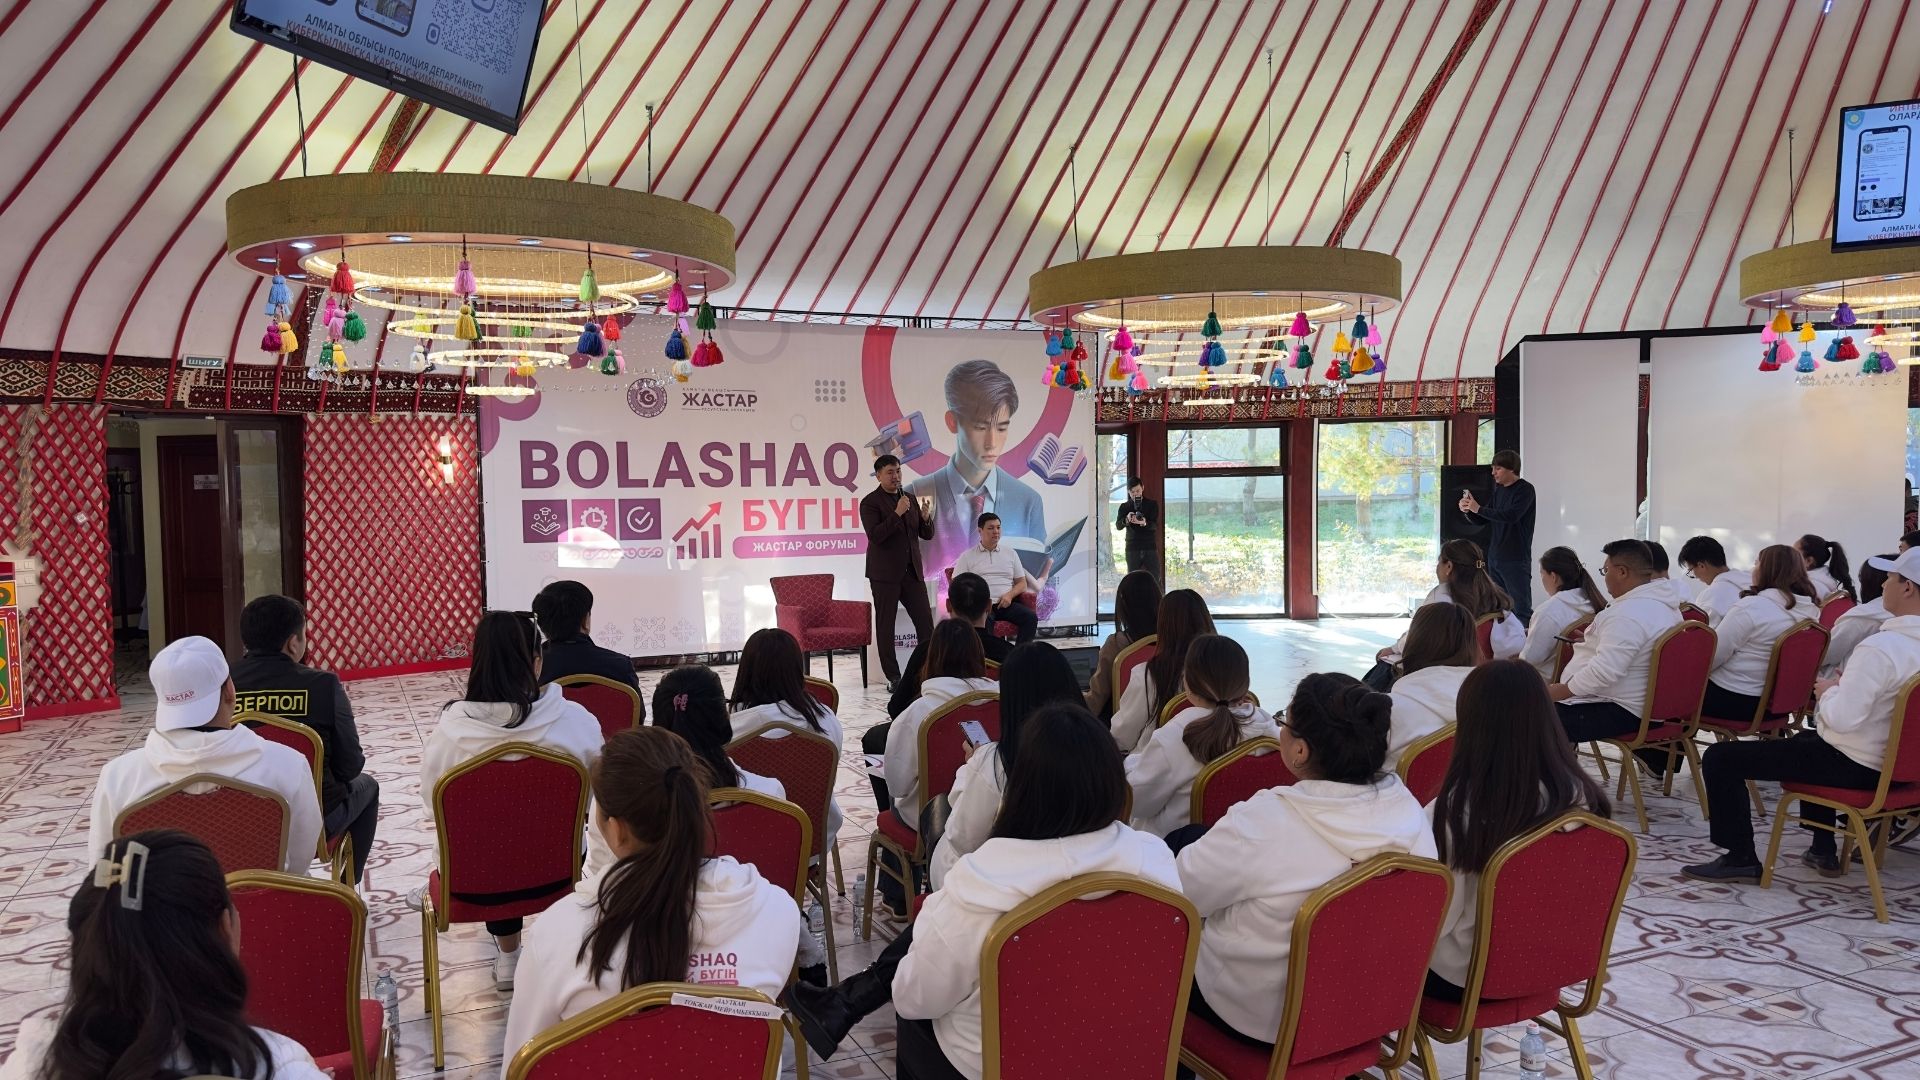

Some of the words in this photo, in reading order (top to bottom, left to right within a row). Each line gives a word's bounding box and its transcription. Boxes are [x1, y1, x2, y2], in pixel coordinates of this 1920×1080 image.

[304, 13, 347, 38] АЛМАТЫ
[348, 31, 387, 55] ОБЛЫСЫ
[388, 47, 429, 72] ПОЛИЦИЯ
[1889, 104, 1920, 112] ИНТЕ
[1881, 224, 1916, 232] АЛМАТЫ
[682, 392, 758, 407] ЖАСТАР
[519, 440, 859, 493] BOLASHAQ
[742, 497, 860, 532] БҮГІН
[752, 541, 803, 553] ЖАСТАР
[805, 539, 857, 551] ФОРУМЫ
[894, 633, 918, 641] OLASH
[234, 695, 304, 713] БЕРПОЛ
[688, 952, 738, 968] SHAQ
